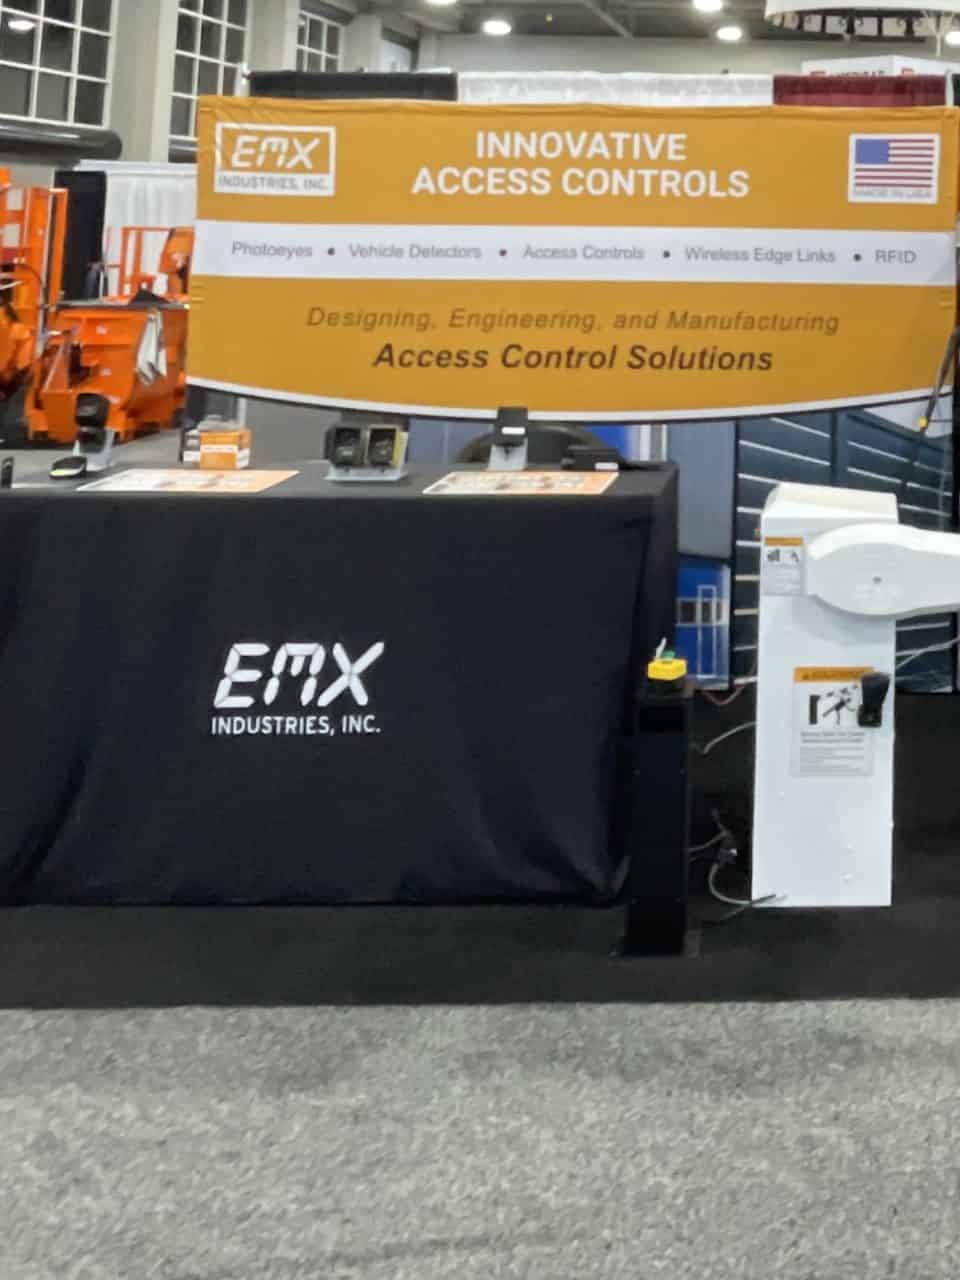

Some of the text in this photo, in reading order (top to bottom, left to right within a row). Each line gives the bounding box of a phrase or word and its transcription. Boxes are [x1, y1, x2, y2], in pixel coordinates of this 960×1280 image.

[231, 134, 321, 169] EMX
[476, 131, 688, 161] INNOVATIVE
[303, 177, 329, 192] INC.
[411, 167, 750, 199] ACCESS CONTROLS
[231, 240, 917, 265] Photoeyes Vehicle Detectors Access Controls Wireless Edge Links RFID
[306, 307, 840, 336] Designing, Engineering, and Manufacturing
[372, 343, 774, 371] Access Control Solutions
[214, 641, 385, 709] EMX
[210, 714, 382, 736] INDUSTRIES, INC.
